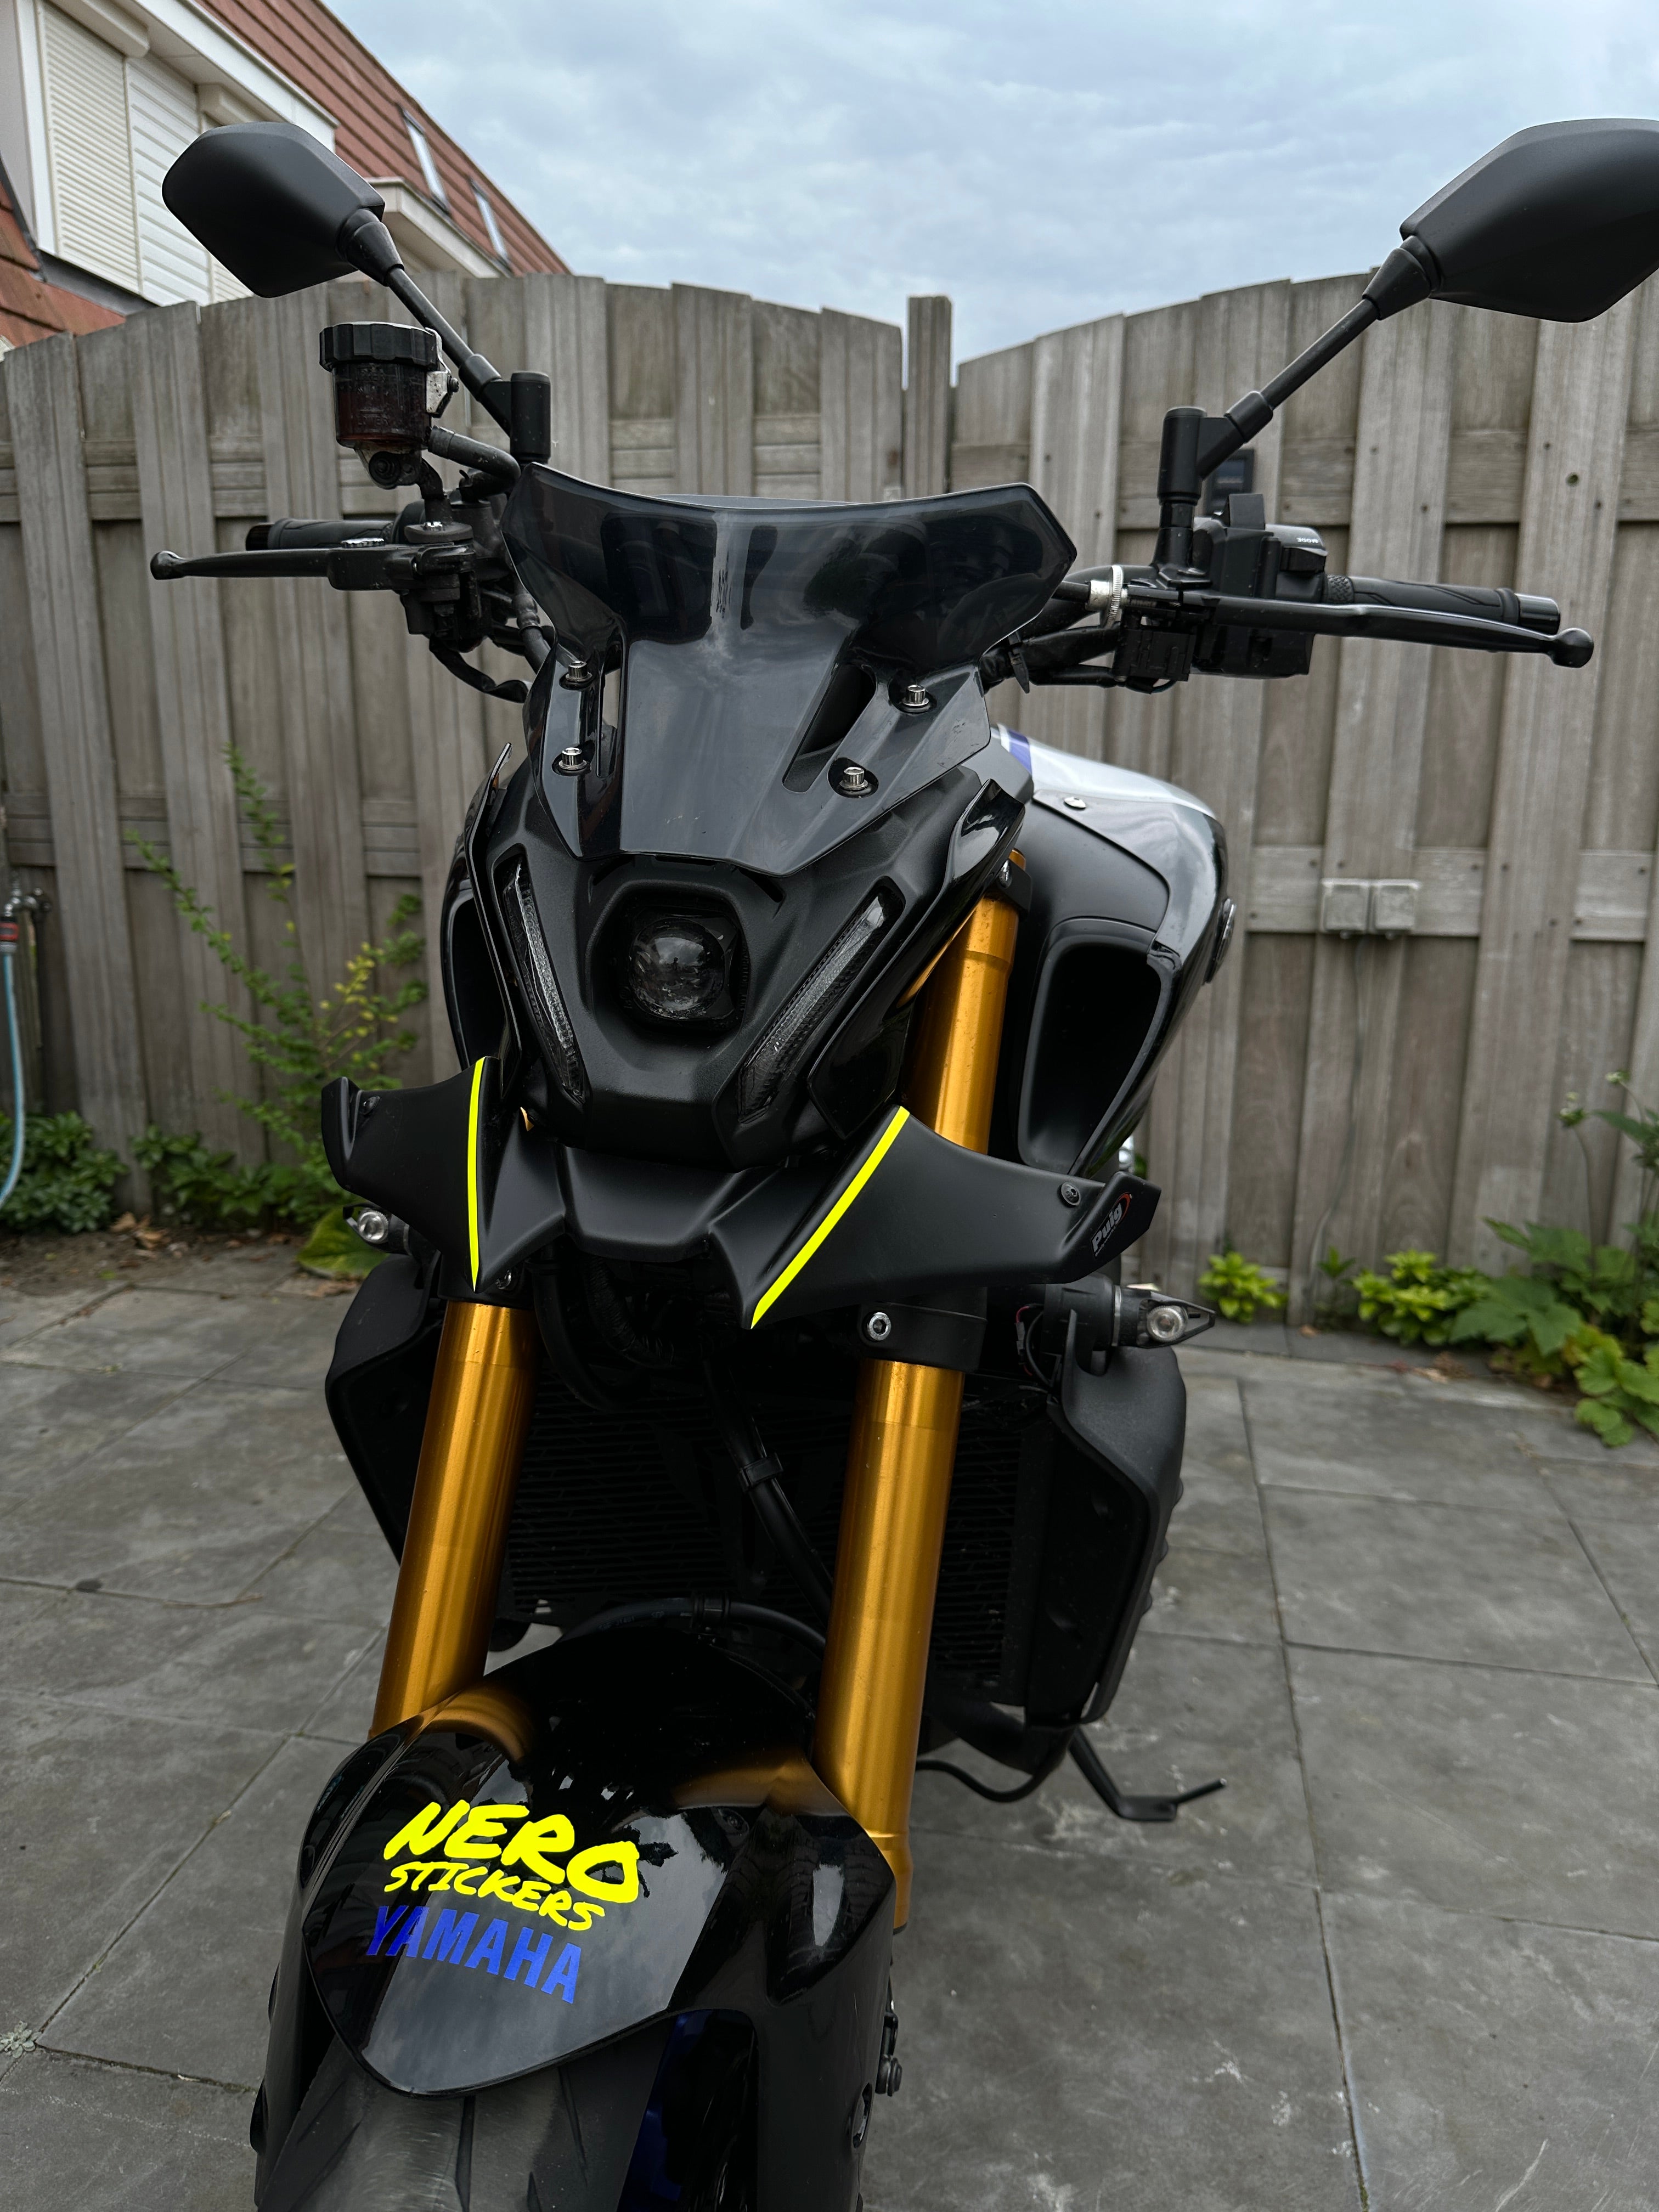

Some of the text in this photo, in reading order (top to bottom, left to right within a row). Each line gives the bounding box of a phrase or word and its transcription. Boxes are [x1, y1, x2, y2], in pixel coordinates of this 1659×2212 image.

[1092, 1203, 1122, 1252] Puig
[384, 1800, 639, 1903] NERO
[384, 1861, 605, 1931] STICKERS
[366, 1905, 582, 2004] YAMAHA
